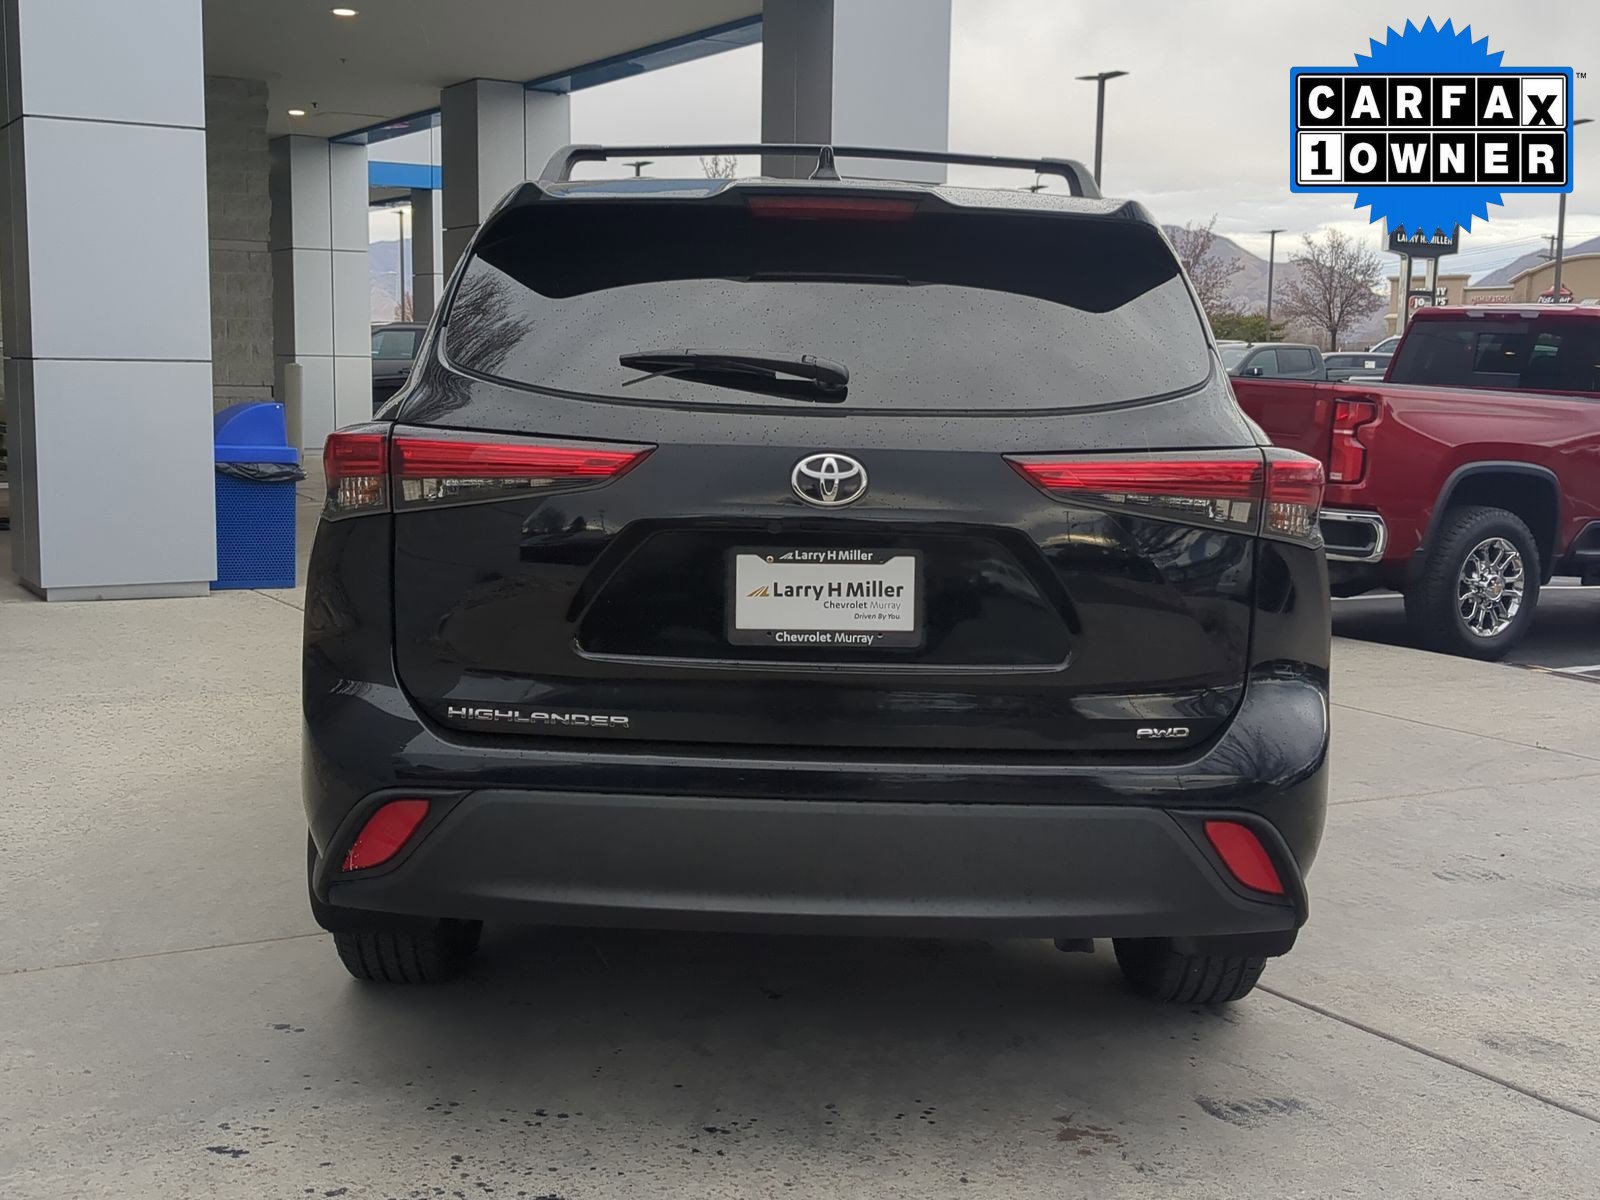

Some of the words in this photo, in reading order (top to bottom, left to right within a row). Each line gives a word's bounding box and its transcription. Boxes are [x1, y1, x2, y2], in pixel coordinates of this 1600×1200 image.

[1397, 233, 1419, 243] LAY
[794, 550, 826, 563] Larry
[827, 551, 837, 561] H
[838, 550, 874, 561] Miller
[773, 582, 824, 600] Larry
[828, 583, 842, 597] H
[846, 581, 904, 598] Miller
[823, 600, 867, 609] Chevrolet
[870, 601, 901, 610] Murray
[775, 631, 832, 643] Chevrolet
[833, 632, 875, 646] Murray
[447, 706, 630, 728] HIGHLANDER
[1136, 727, 1190, 739] AWD
